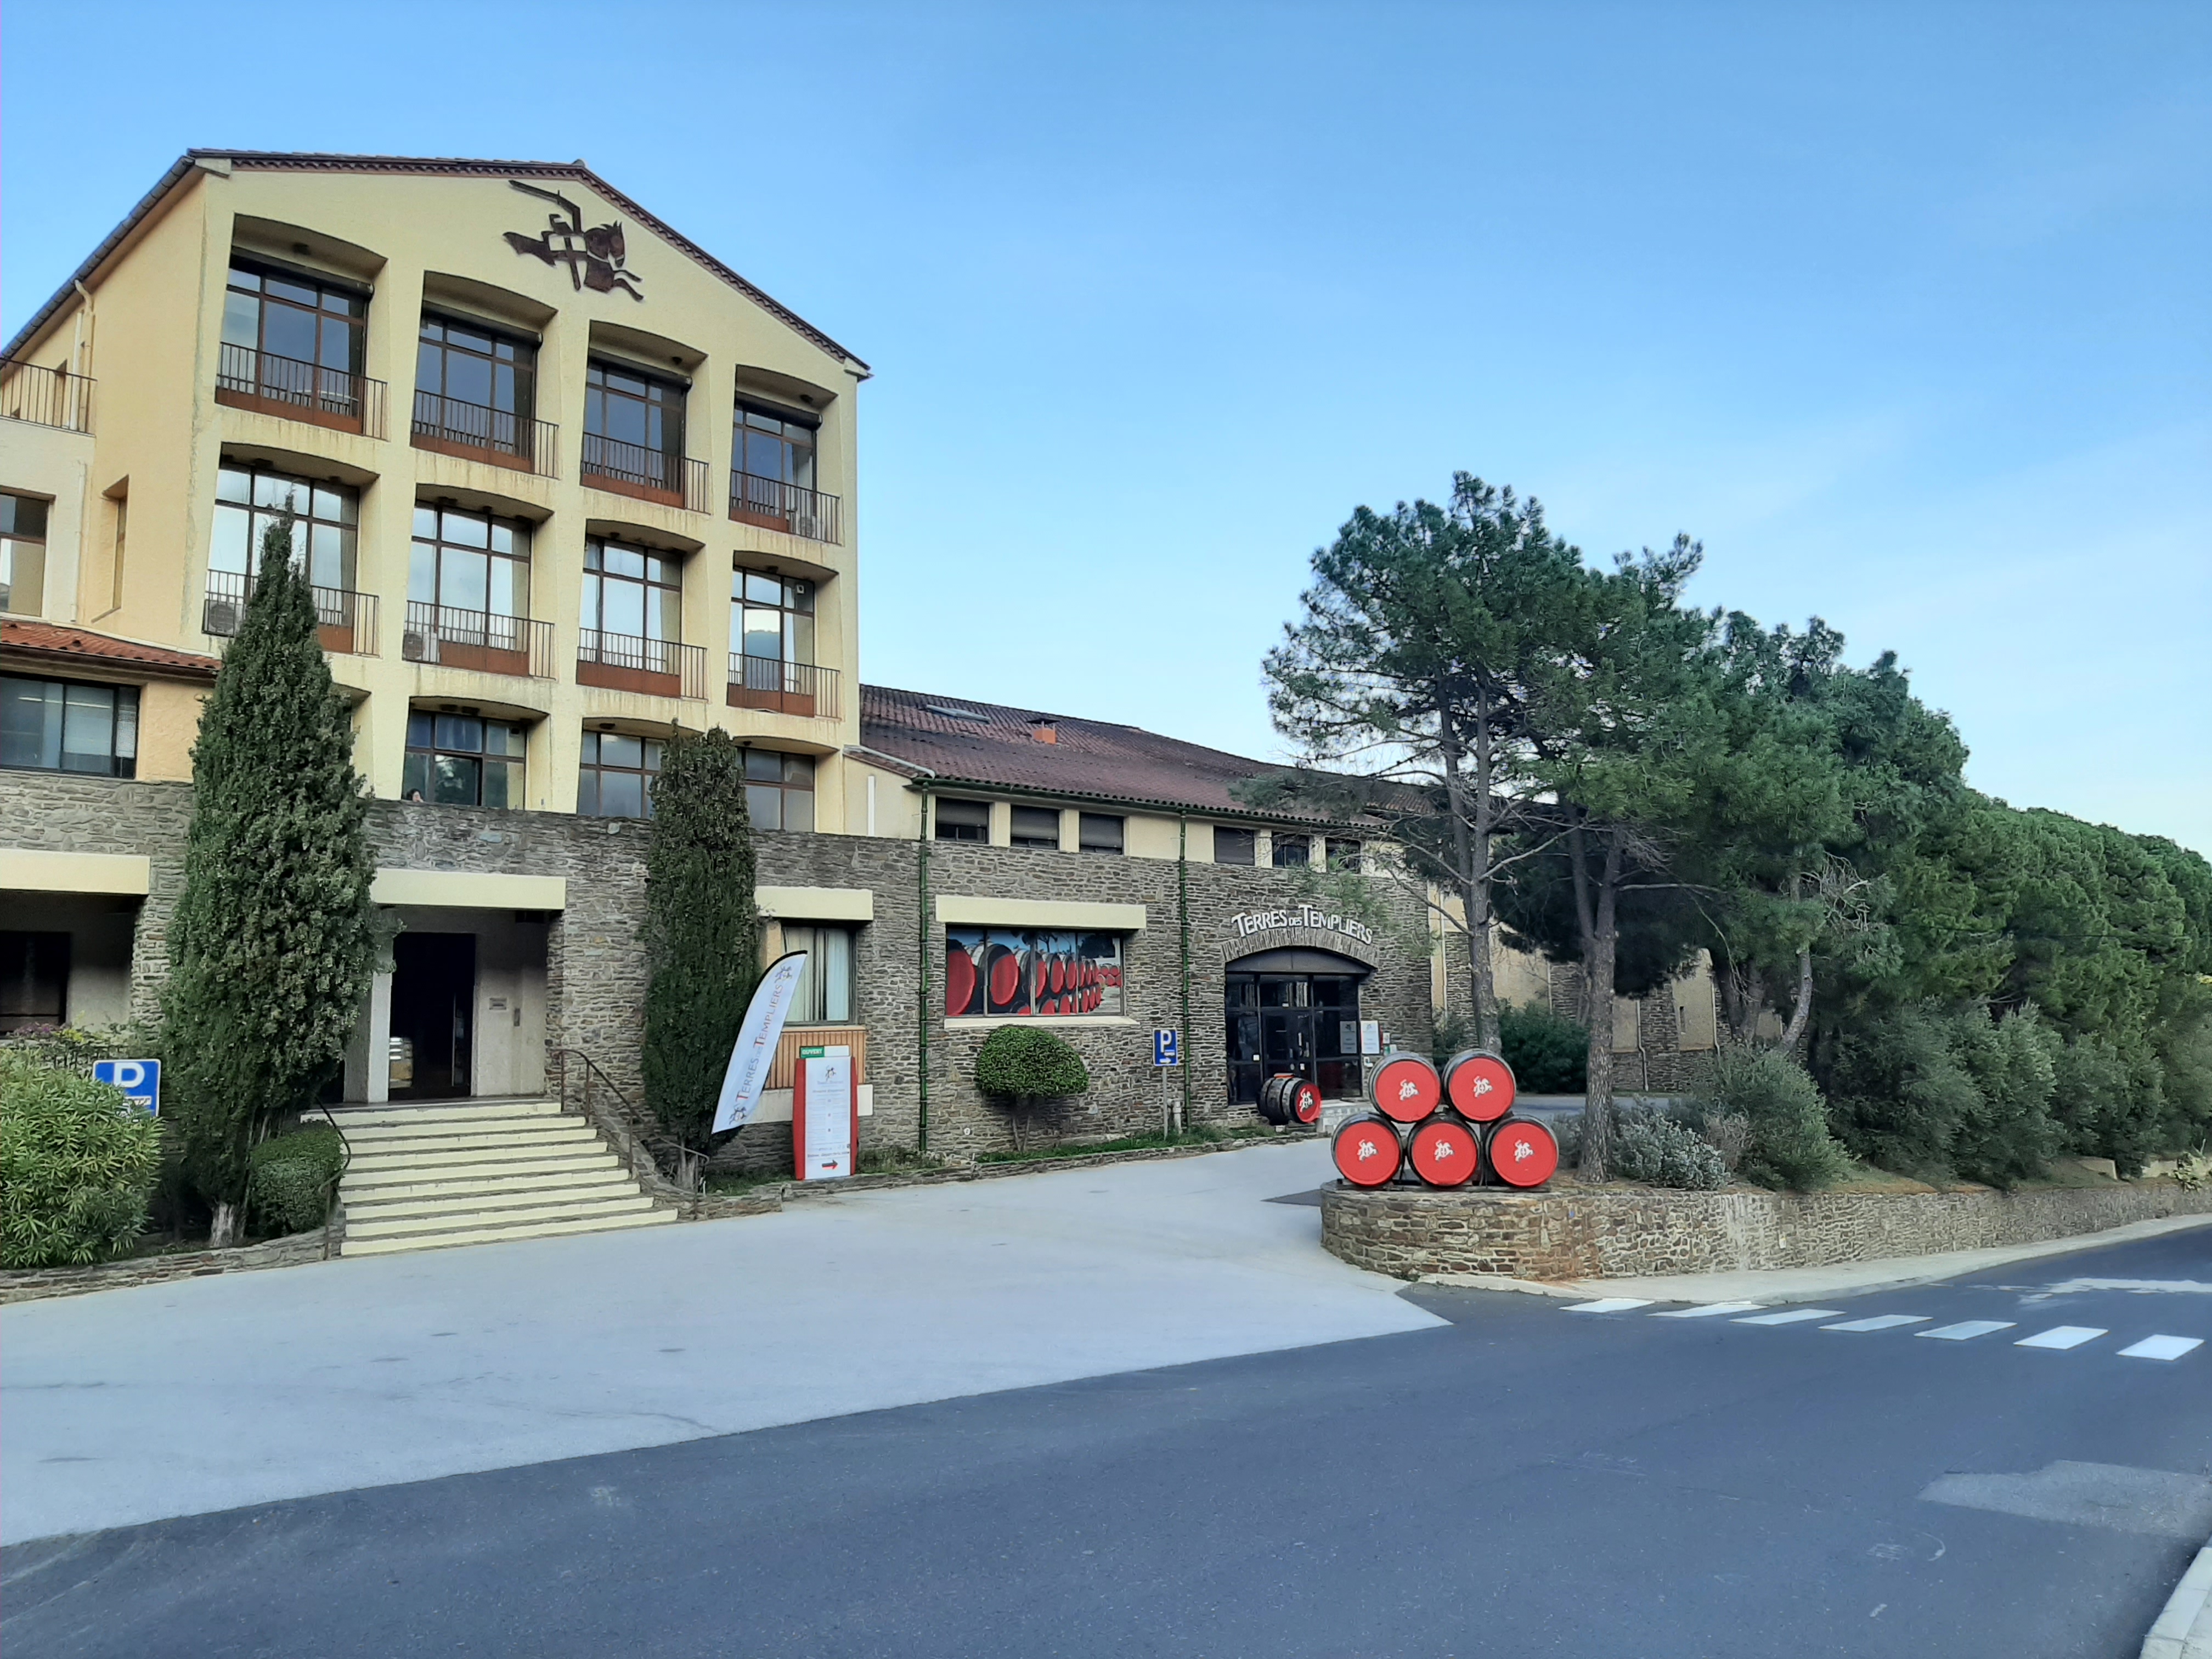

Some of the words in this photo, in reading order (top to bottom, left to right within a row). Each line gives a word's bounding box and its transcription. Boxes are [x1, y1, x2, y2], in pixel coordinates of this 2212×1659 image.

[1231, 910, 1288, 937] TERRES
[1289, 917, 1302, 926] DES
[1299, 904, 1373, 945] TEMPLIERS
[736, 1057, 759, 1102] TERRES
[753, 984, 783, 1048] TEMPLIERS
[1160, 1029, 1172, 1053] P
[114, 1062, 145, 1088] P
